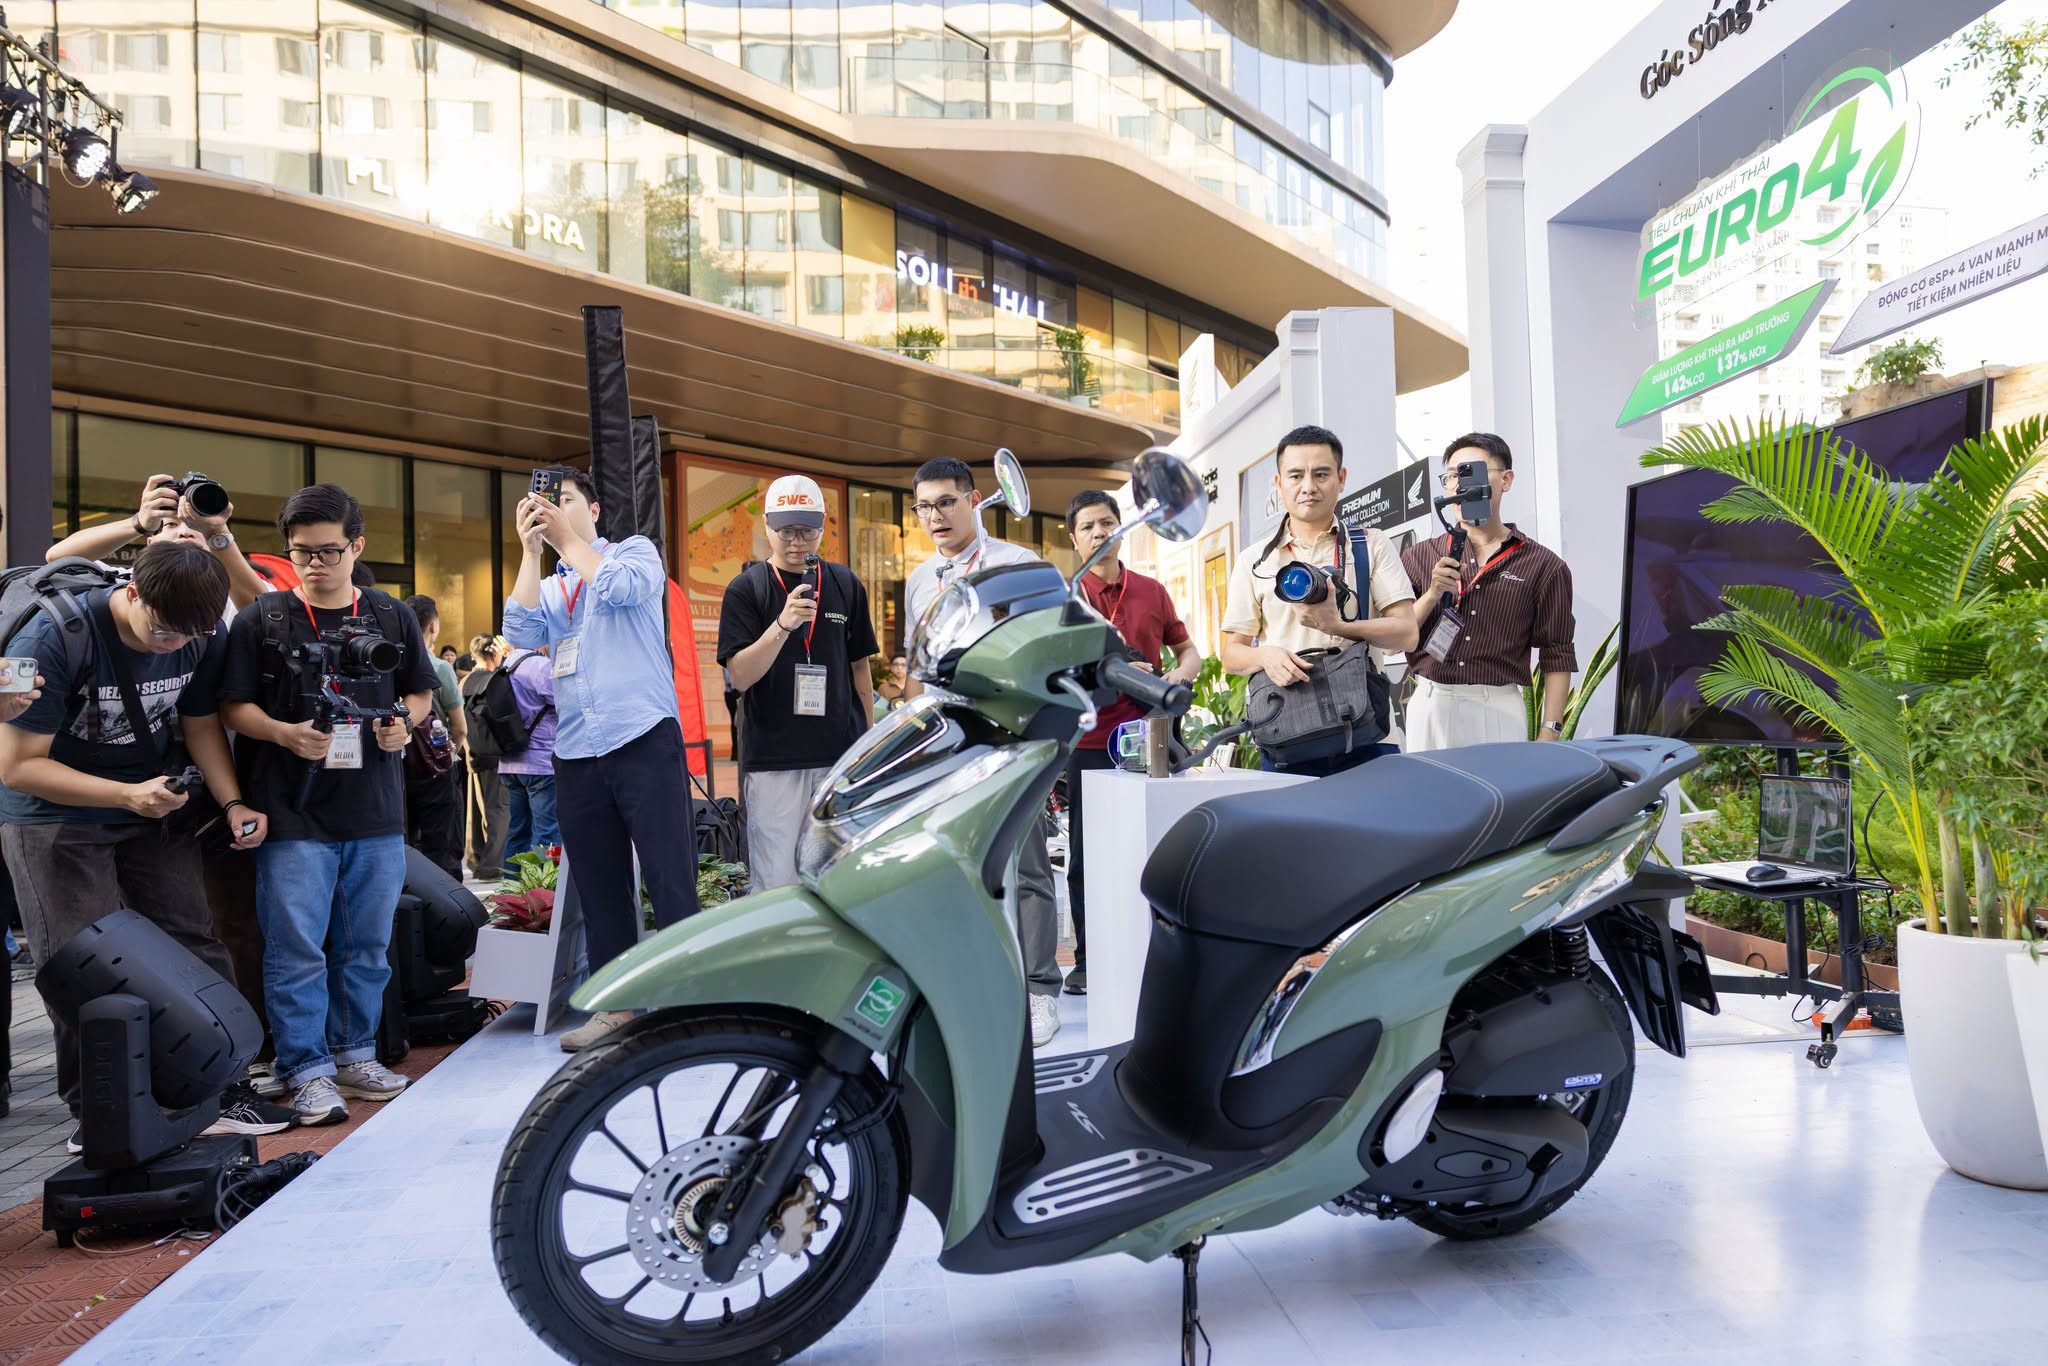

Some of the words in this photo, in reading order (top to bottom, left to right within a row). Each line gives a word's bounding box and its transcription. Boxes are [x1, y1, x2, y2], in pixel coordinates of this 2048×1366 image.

[1640, 49, 1685, 100] Góc
[1688, 0, 1754, 65] Sống
[1878, 286, 1908, 308] ĐỘNG
[1910, 275, 1927, 294] CƠ
[1928, 267, 1955, 287] eSP+
[1957, 261, 1966, 274] 4
[1968, 249, 1993, 270] VAN
[1995, 231, 2034, 259] MẠNH
[2036, 225, 2048, 242] M
[1907, 291, 1929, 313] TIẾT
[1930, 283, 1957, 303] KIỆM
[1959, 269, 1994, 293] NHIÊN
[1996, 256, 2022, 277] LIỆU
[1725, 338, 1737, 350] RA
[1341, 487, 1382, 516] PREMIUM
[1359, 498, 1390, 521] COLLECTION
[141, 671, 194, 695] SECURITY
